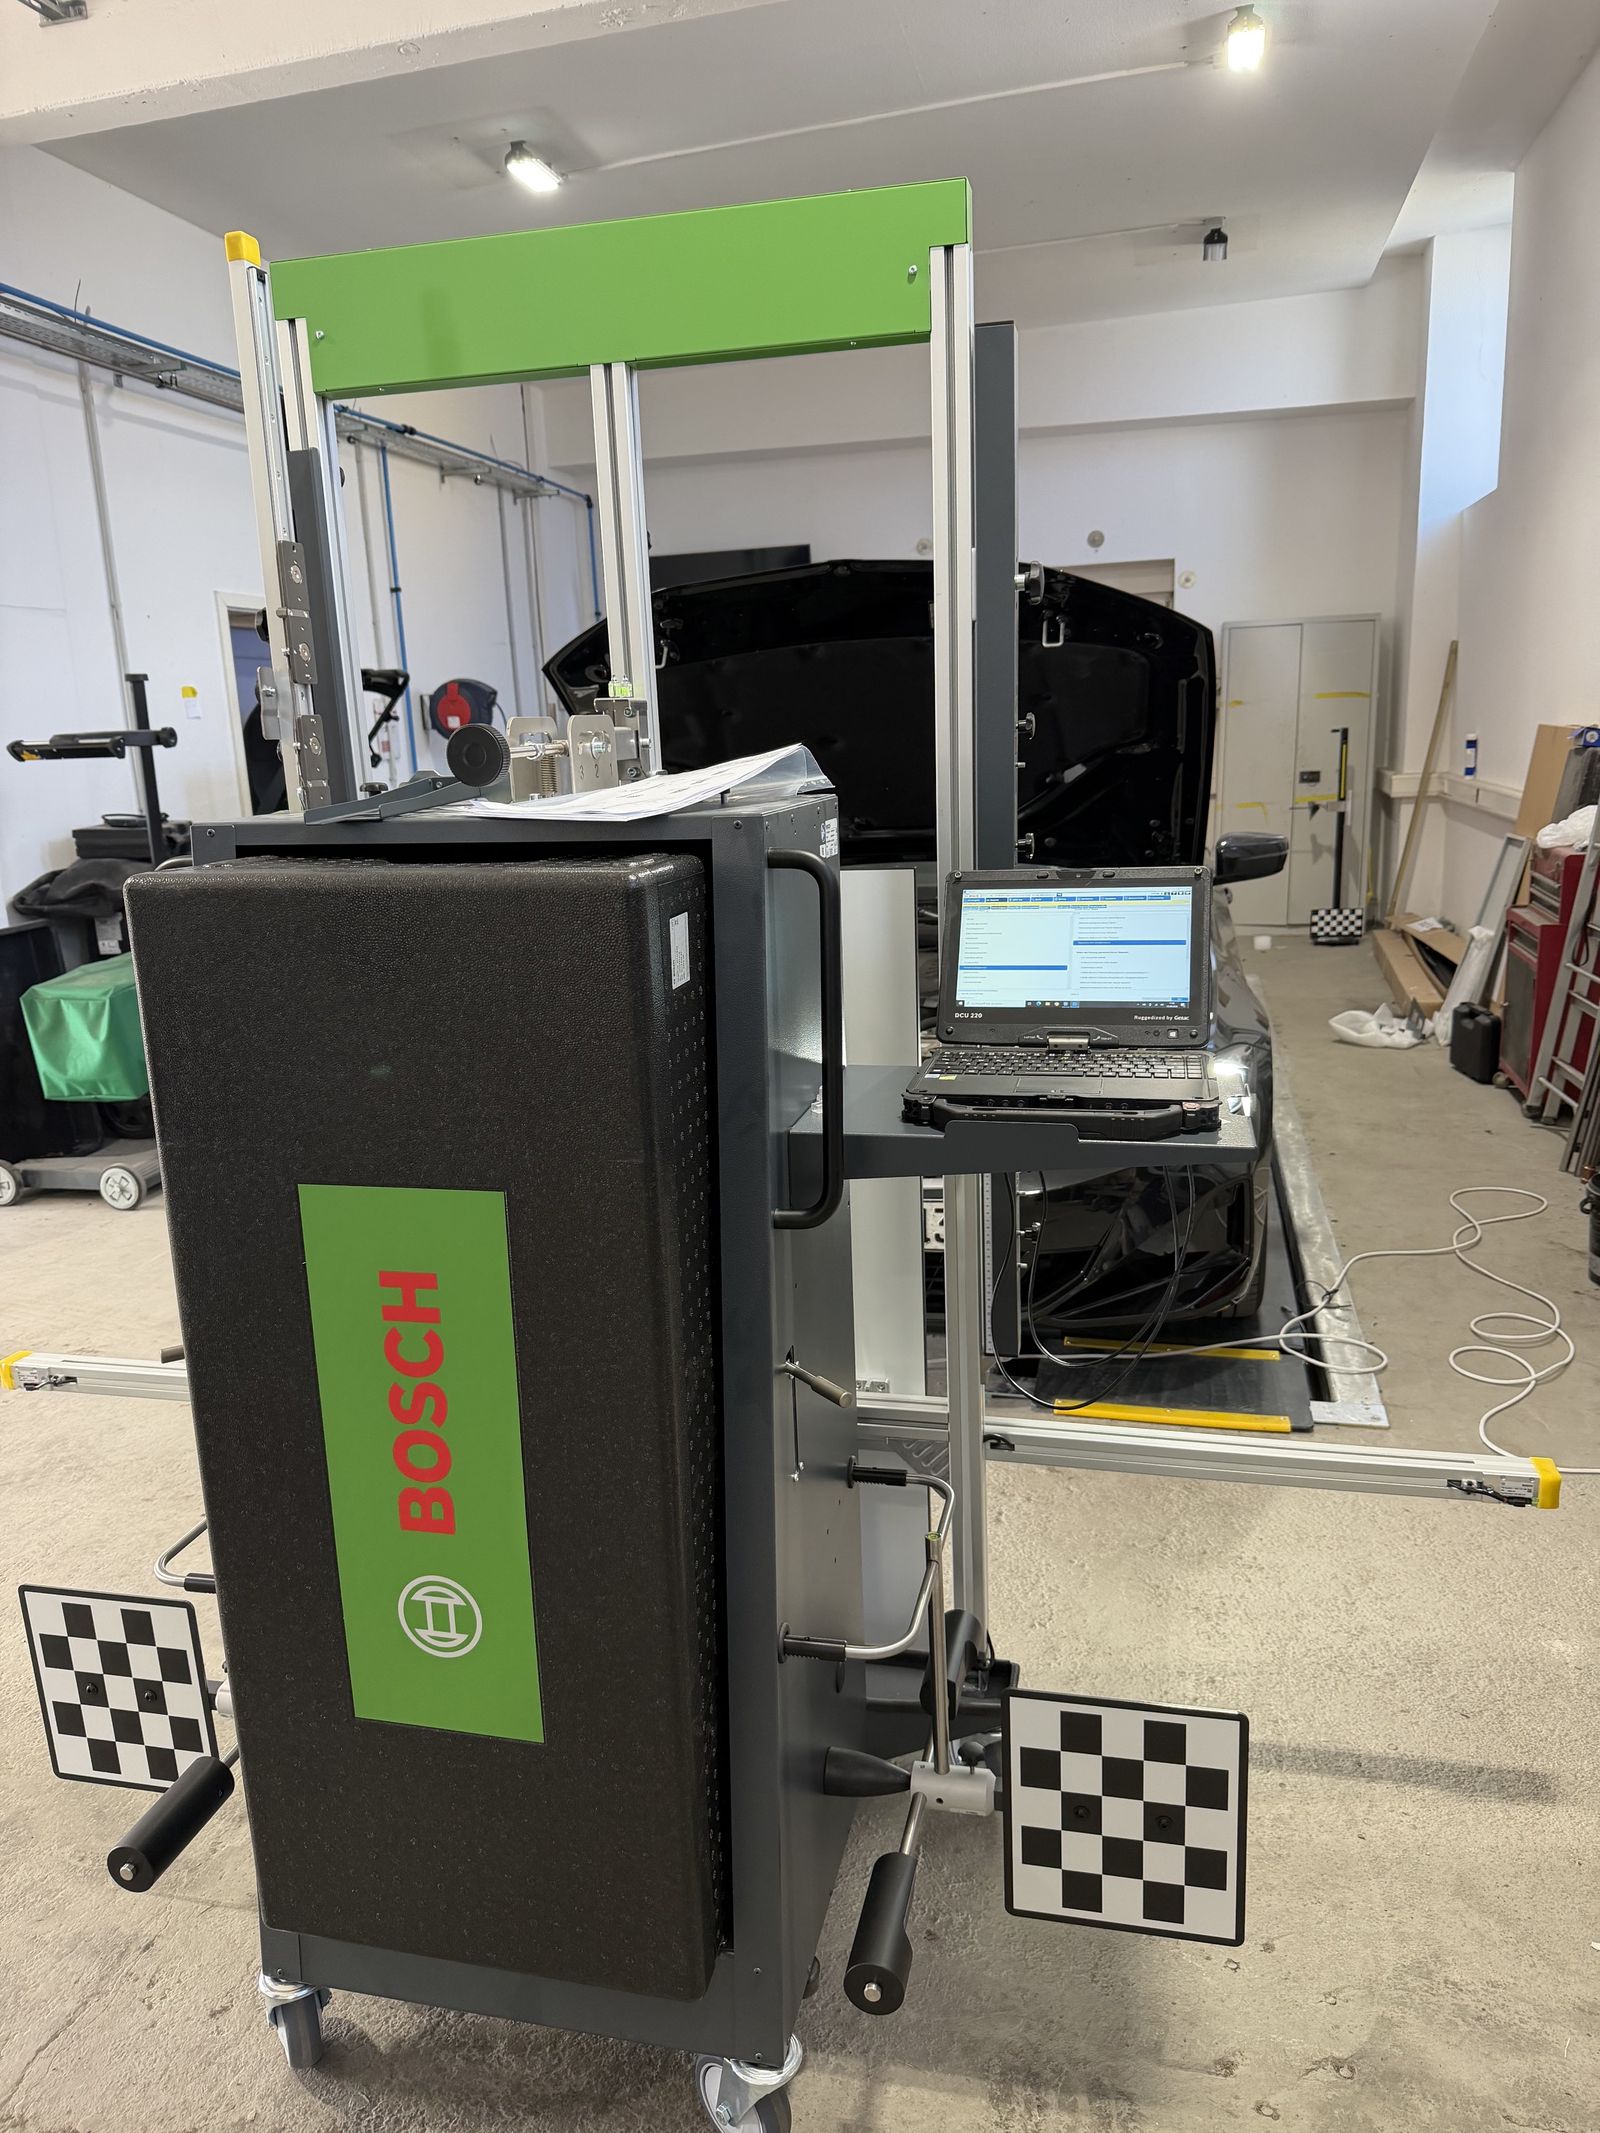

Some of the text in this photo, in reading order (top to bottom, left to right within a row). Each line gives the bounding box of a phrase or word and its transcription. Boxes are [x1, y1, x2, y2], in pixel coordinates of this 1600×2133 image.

[579, 764, 585, 780] 3
[594, 763, 600, 778] 2
[378, 1270, 456, 1535] BOSCH
